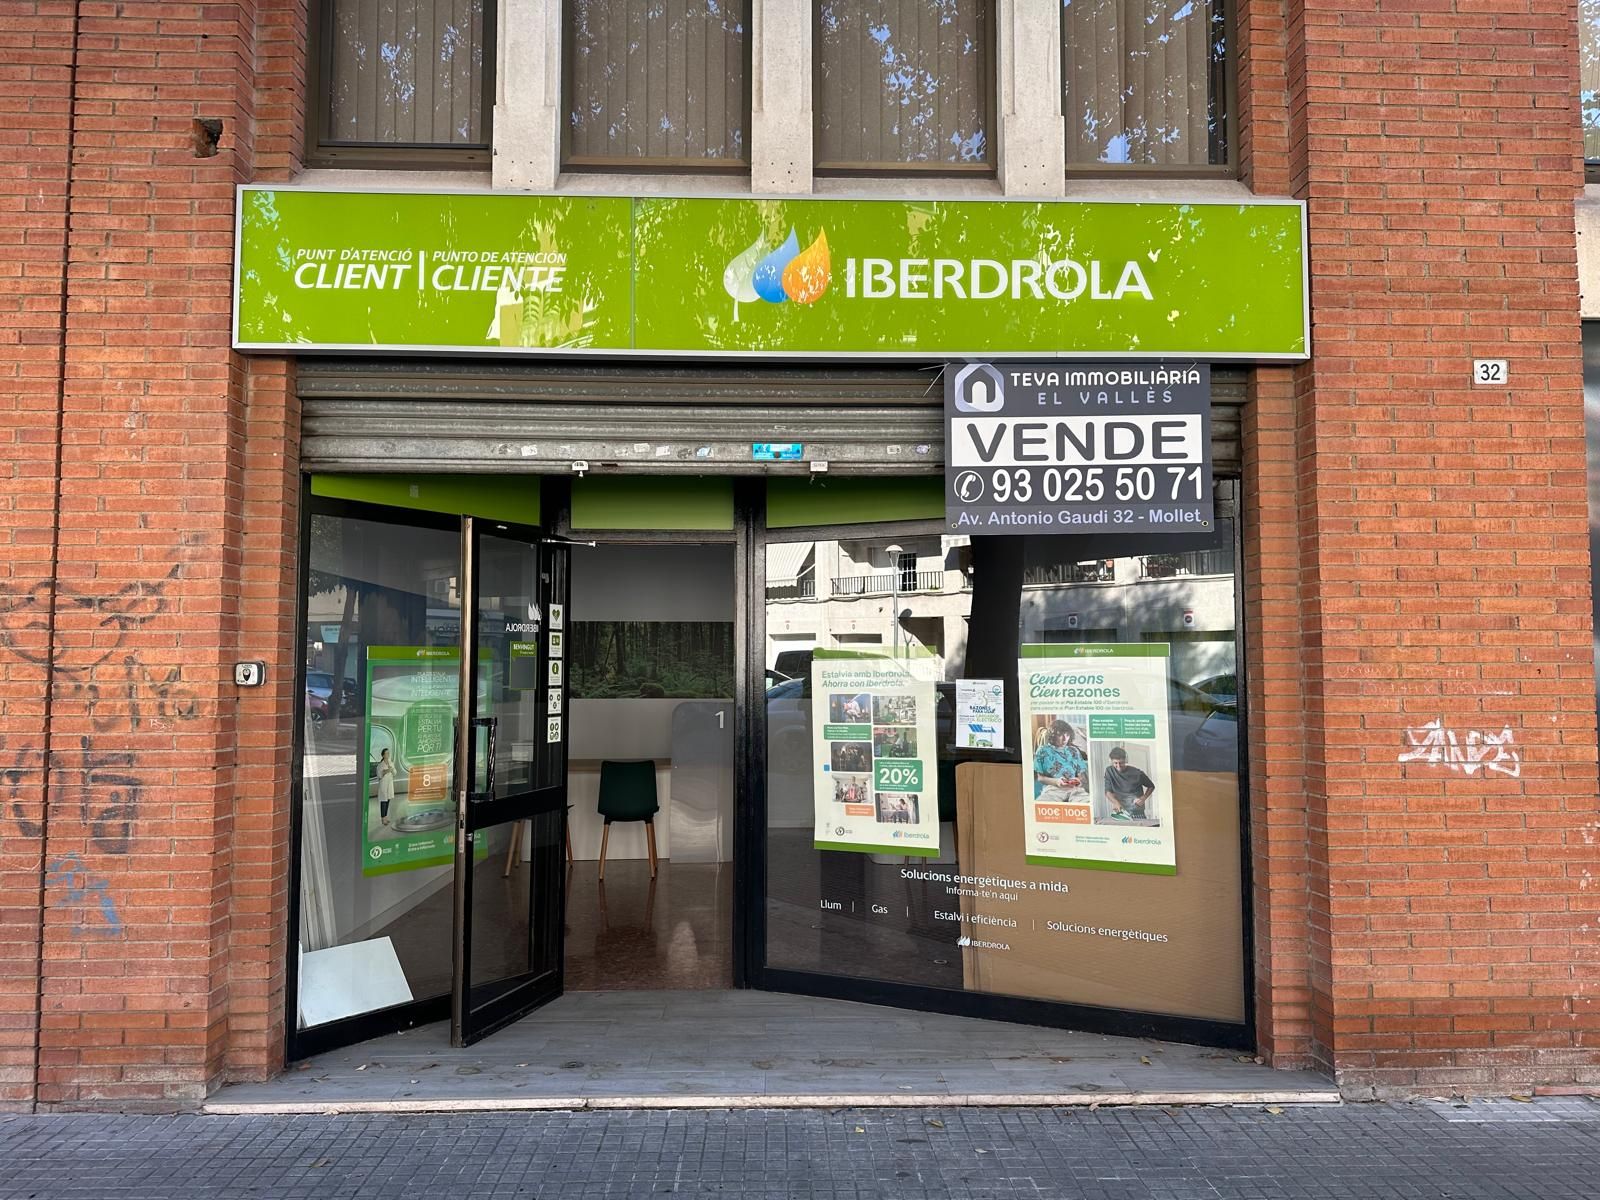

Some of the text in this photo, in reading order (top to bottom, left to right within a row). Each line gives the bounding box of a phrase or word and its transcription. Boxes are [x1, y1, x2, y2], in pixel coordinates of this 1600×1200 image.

[296, 246, 413, 262] PUNT D'ATENCIÓ
[432, 249, 567, 264] PUNTO DE ATENCIÓN
[294, 262, 412, 290] CLIENT
[431, 264, 567, 293] CLIENTE
[845, 257, 1154, 301] IBERDROLA
[1010, 366, 1201, 388] TEVA IMMOBILIÀRIA
[1480, 363, 1501, 382] 32
[1038, 386, 1173, 405] EL VALLÈS
[966, 421, 1189, 463] VENDE
[992, 466, 1202, 502] 93 025 50 71
[958, 511, 983, 526] Av.
[987, 511, 1054, 526] Antonio
[1057, 510, 1109, 525] Gaudi
[1112, 509, 1135, 524] 32
[1148, 508, 1202, 523] Mollet
[821, 670, 852, 679] Estalvia
[853, 670, 872, 679] amb
[822, 679, 849, 688] Ahorra
[1029, 672, 1104, 686] Cent raons
[1029, 685, 1121, 698] Cien razones
[715, 710, 725, 729] 1
[423, 774, 431, 788] 8
[879, 767, 919, 785] 20%
[1037, 807, 1061, 817] 100€
[1063, 808, 1089, 818] 100€
[1134, 838, 1162, 846] Iberdrola
[900, 868, 1069, 893] Solucions energètiques a mida
[946, 886, 998, 899] Informa-te'n
[820, 899, 842, 910] Llum
[871, 904, 889, 914] Gas
[934, 910, 964, 922] Estalvi
[971, 914, 1017, 928] eficiència
[1046, 920, 1096, 935] Solucions
[1098, 927, 1169, 943] energètiques
[971, 940, 1011, 951] IBERDROLA
